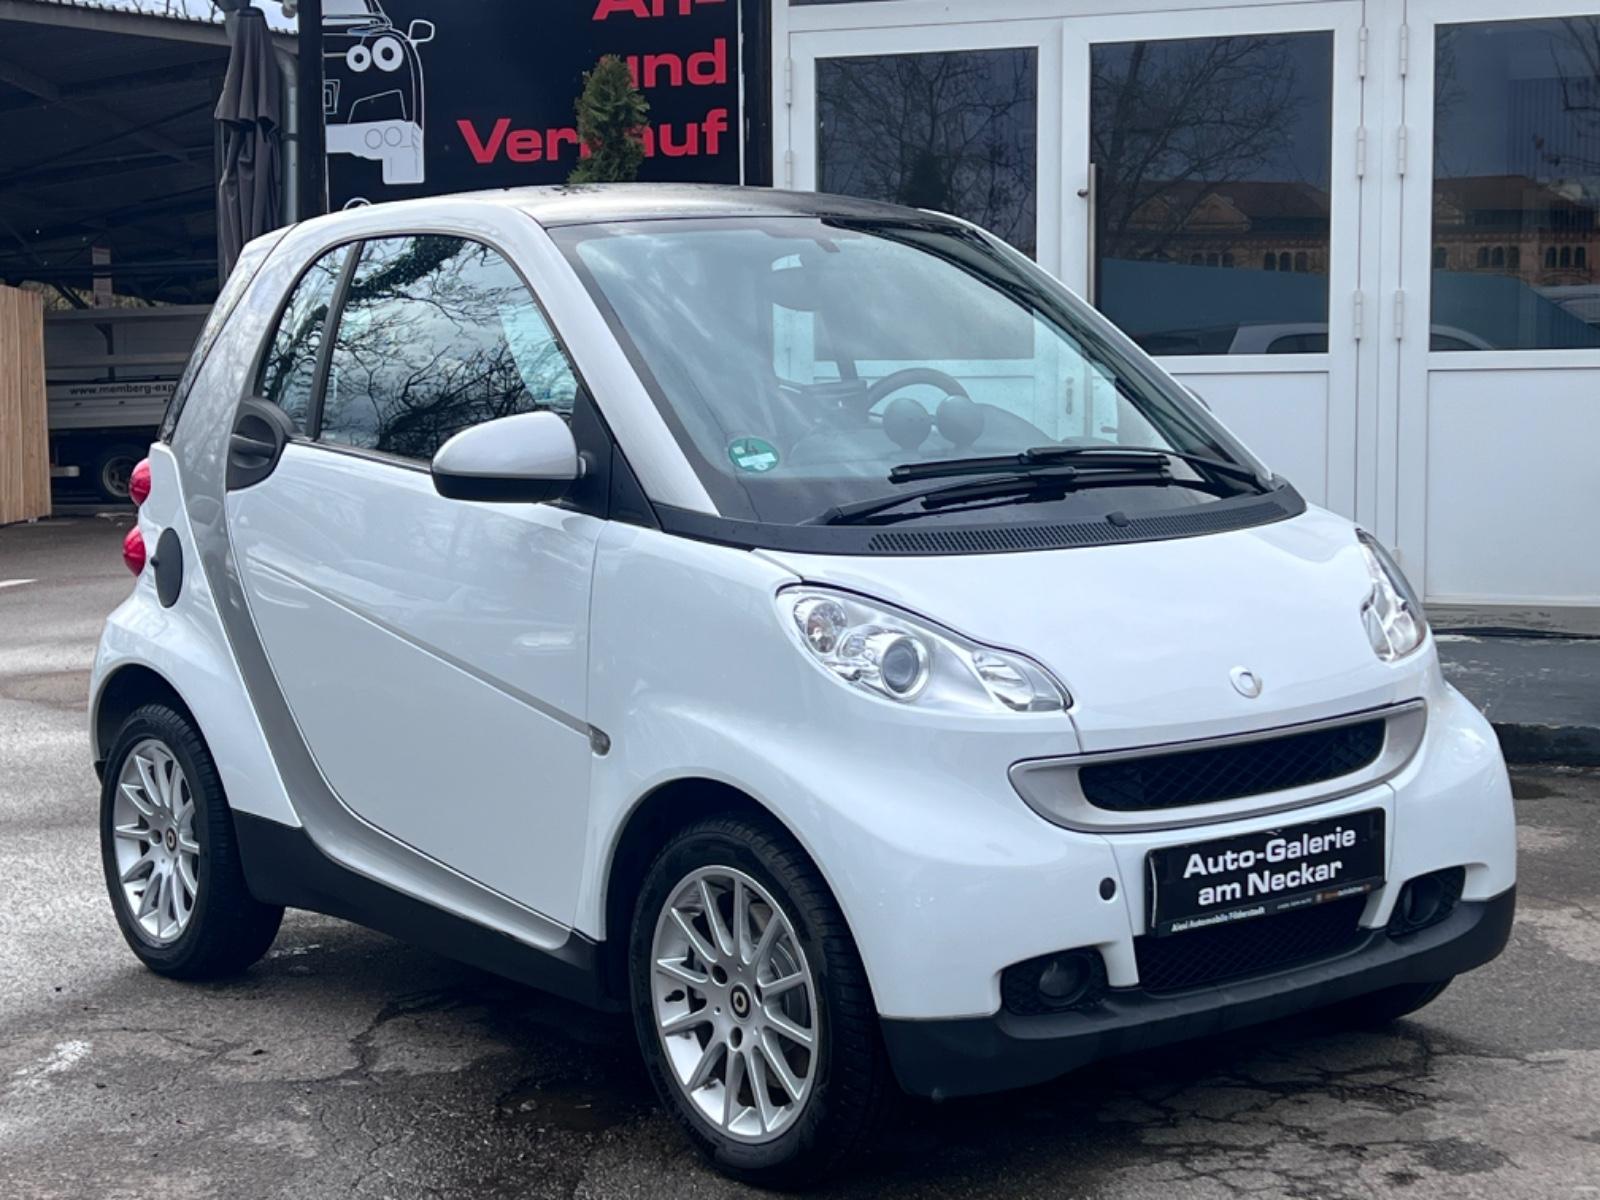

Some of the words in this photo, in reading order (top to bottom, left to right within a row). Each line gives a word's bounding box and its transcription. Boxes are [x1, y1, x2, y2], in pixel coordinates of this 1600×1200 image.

[456, 108, 728, 164] Veruf
[1182, 826, 1357, 880] Auto-Galerie
[1197, 882, 1241, 906] am
[1246, 860, 1343, 897] Neckar
